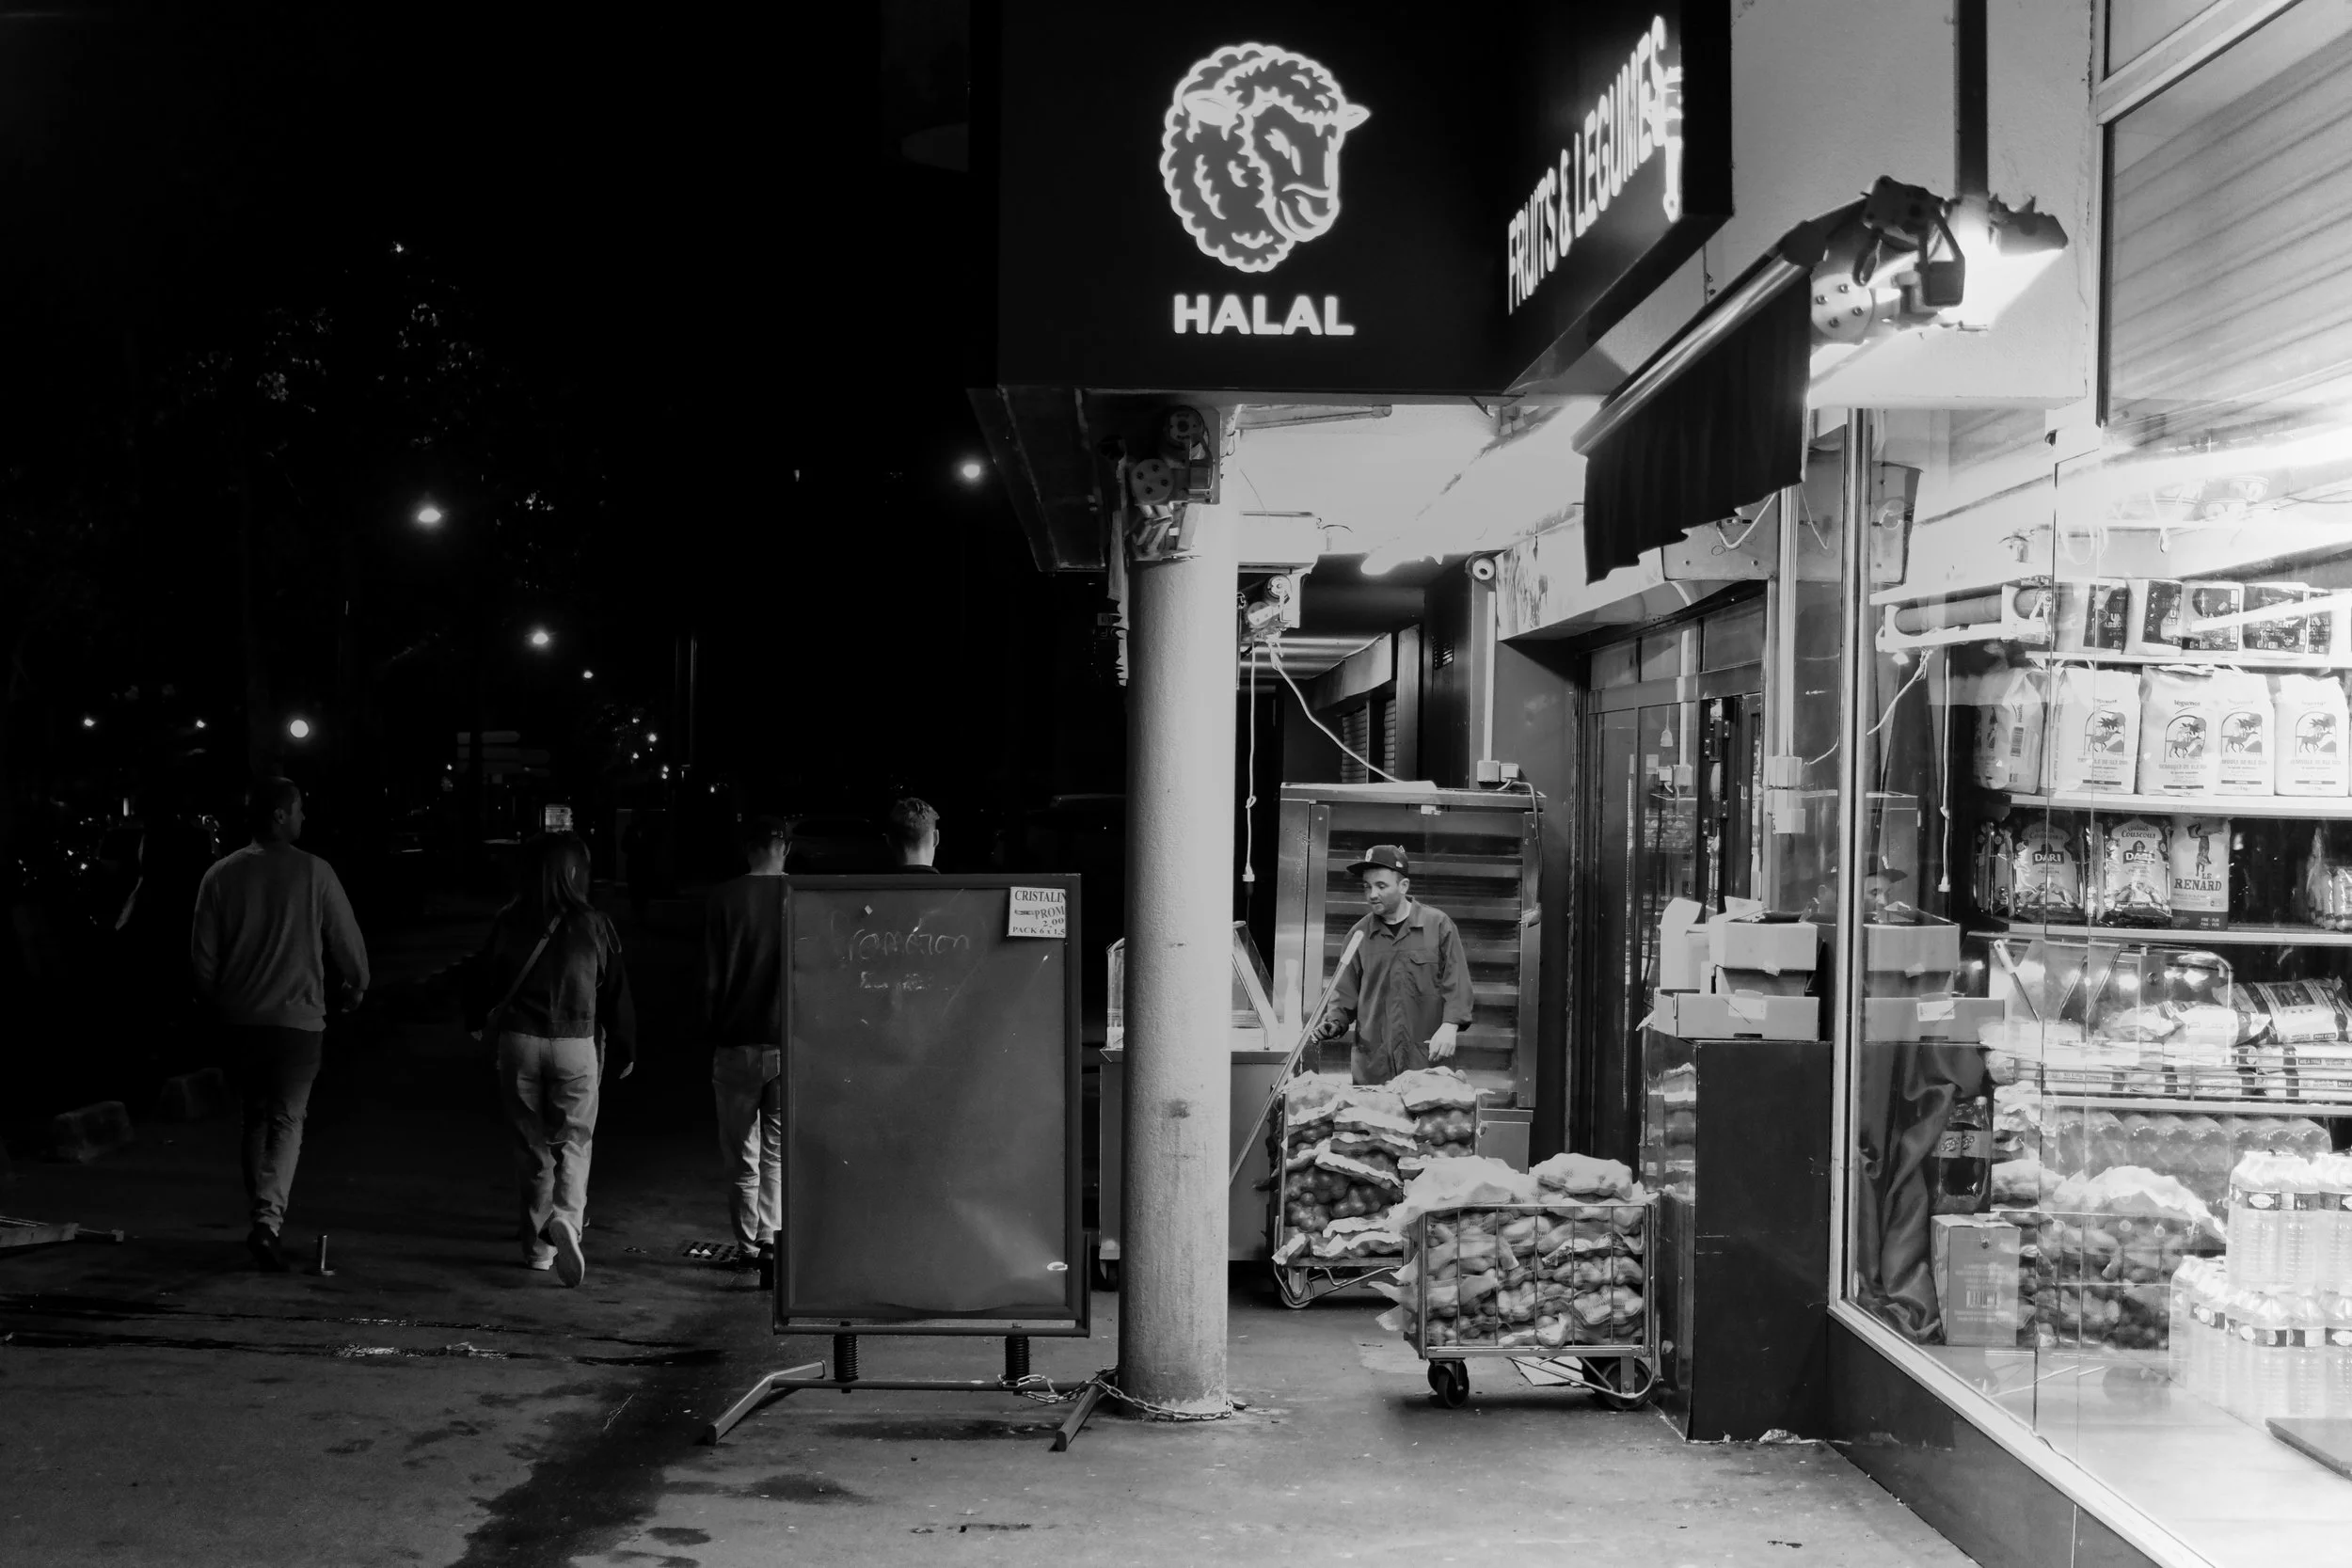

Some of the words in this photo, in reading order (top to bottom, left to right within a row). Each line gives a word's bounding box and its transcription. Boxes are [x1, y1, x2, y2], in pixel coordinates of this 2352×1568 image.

[1508, 166, 1557, 315] FRUITS
[1559, 148, 1573, 258] &
[1574, 15, 1666, 237] LEGUMES
[1173, 293, 1356, 337] HALAL
[2034, 853, 2061, 863] DARI
[2174, 878, 2222, 892] RENARD
[1012, 926, 1037, 934] PACK
